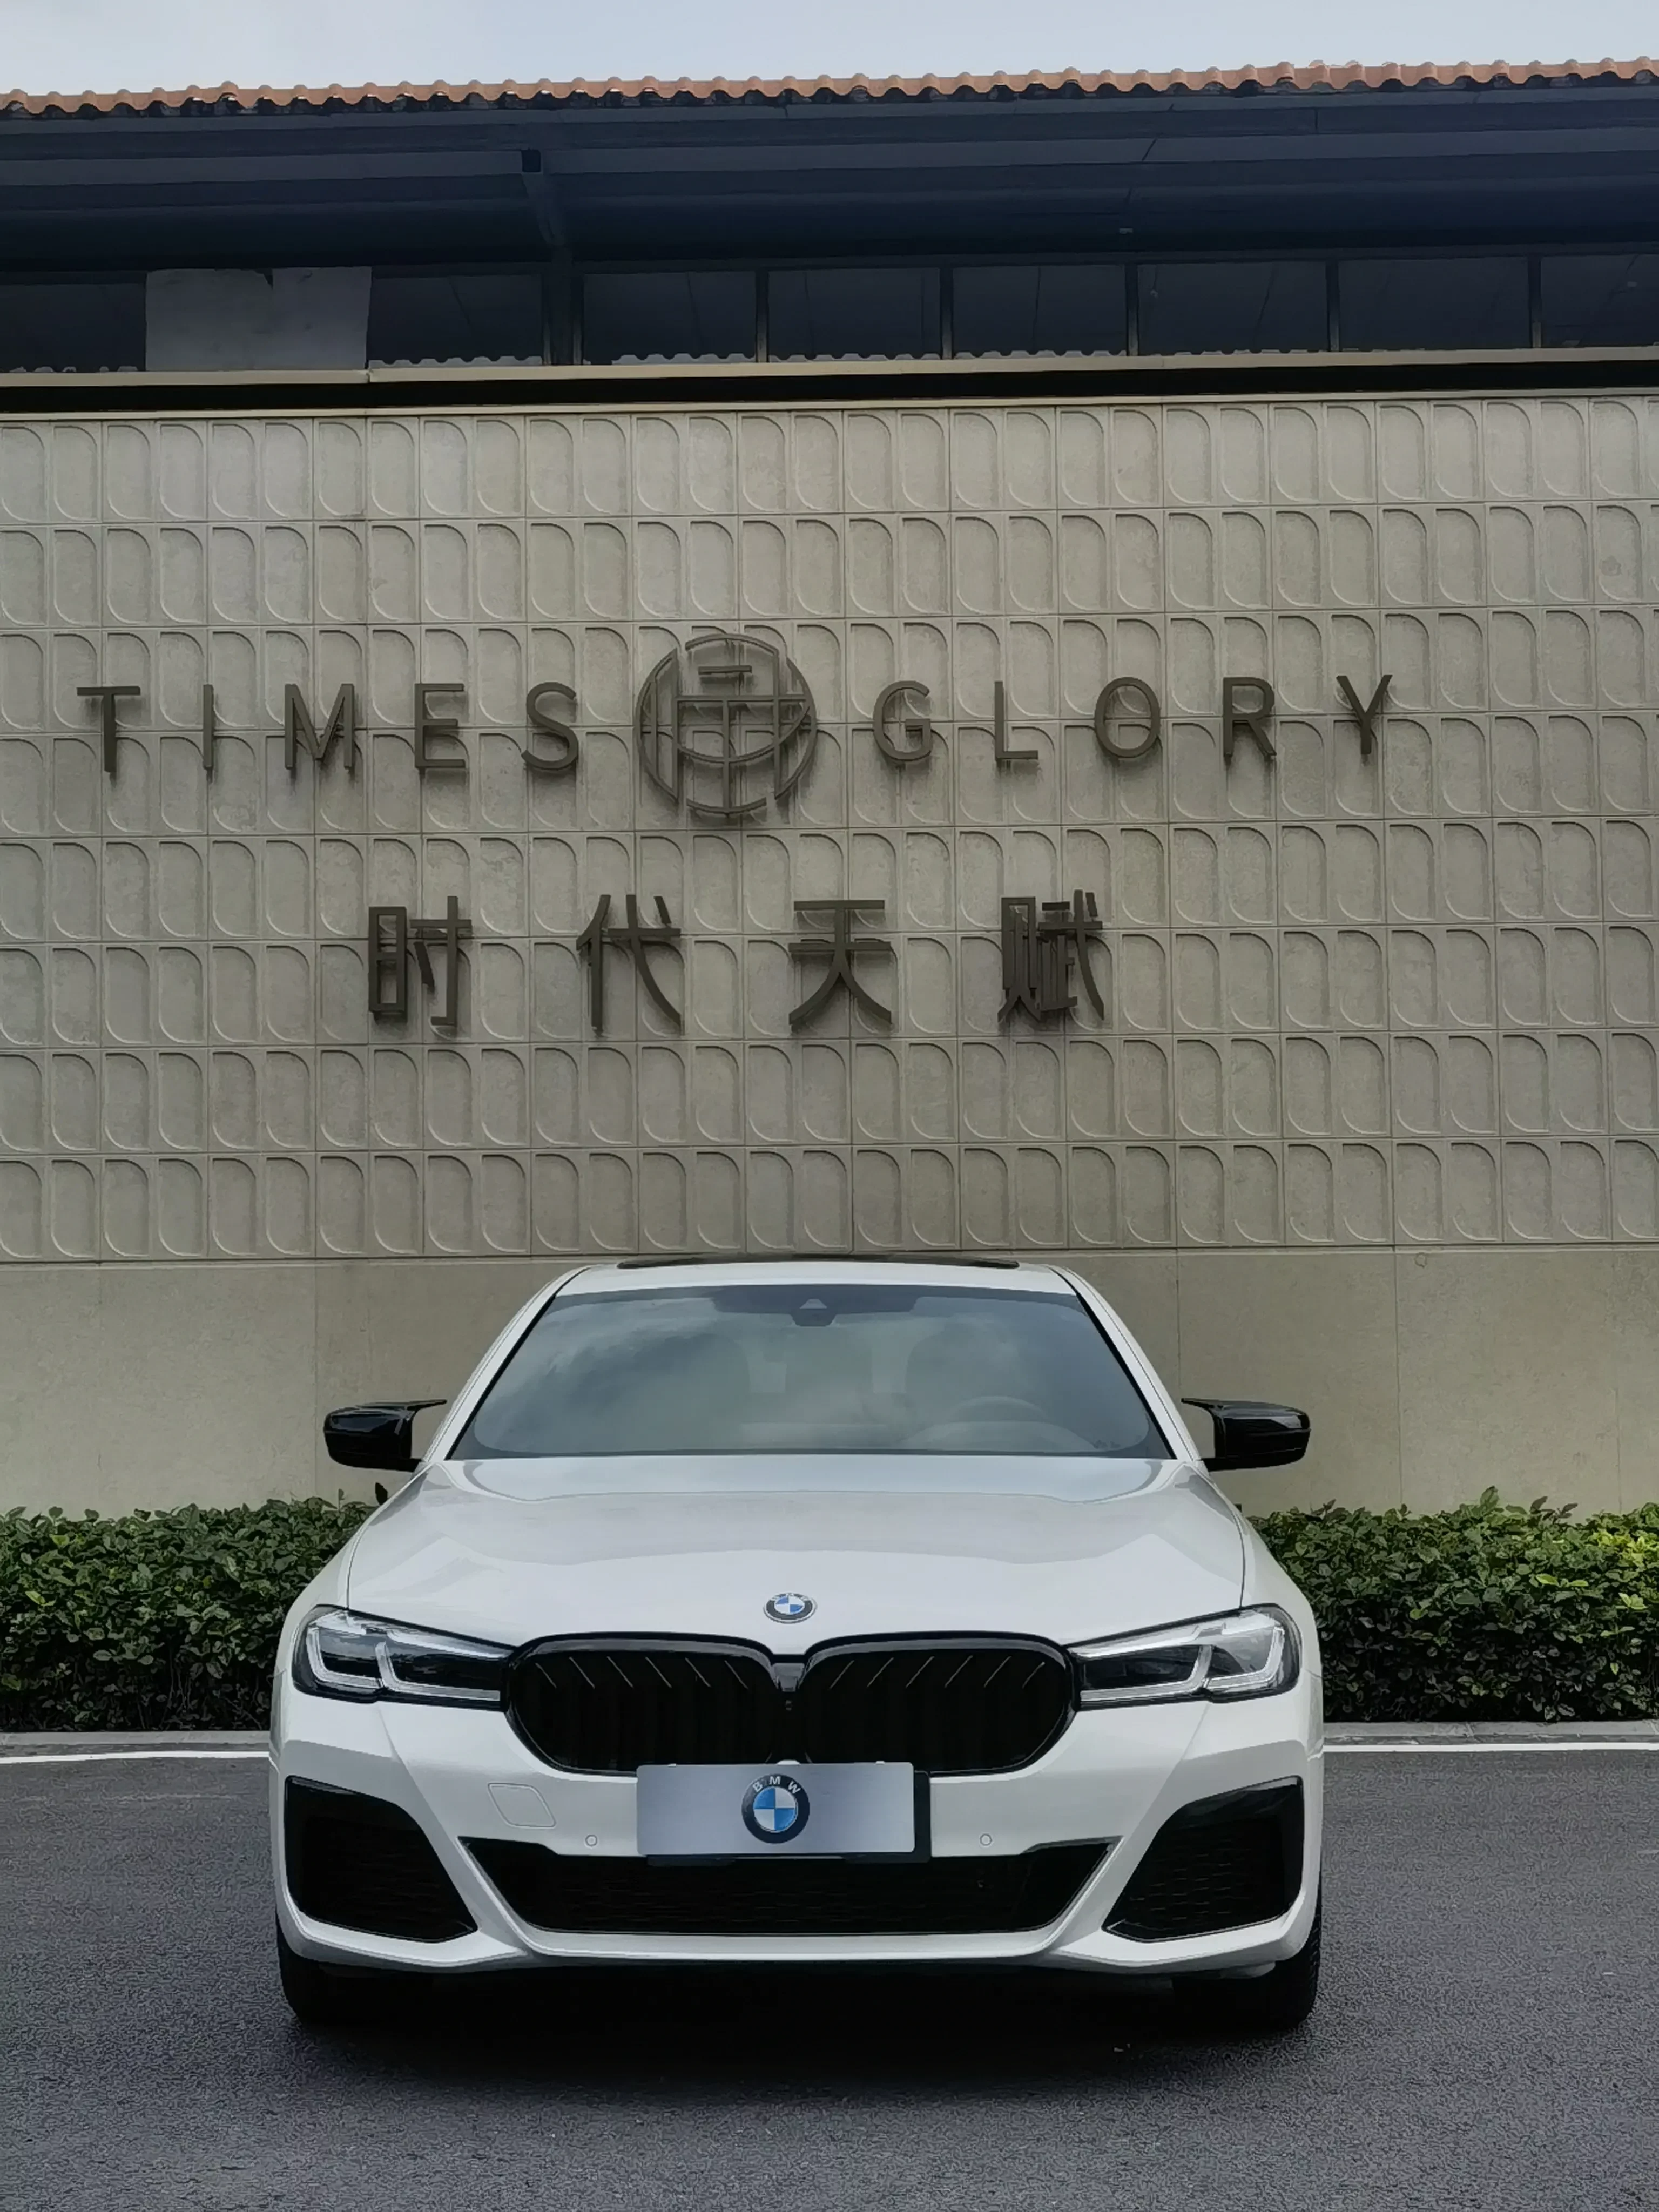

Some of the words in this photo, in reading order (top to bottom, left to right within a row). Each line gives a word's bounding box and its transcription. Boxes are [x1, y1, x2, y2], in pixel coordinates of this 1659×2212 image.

[77, 682, 580, 773] TIMES
[873, 675, 1393, 762] GLORY
[368, 890, 1105, 1030] 时代天赋
[752, 1775, 801, 1794] BMW
